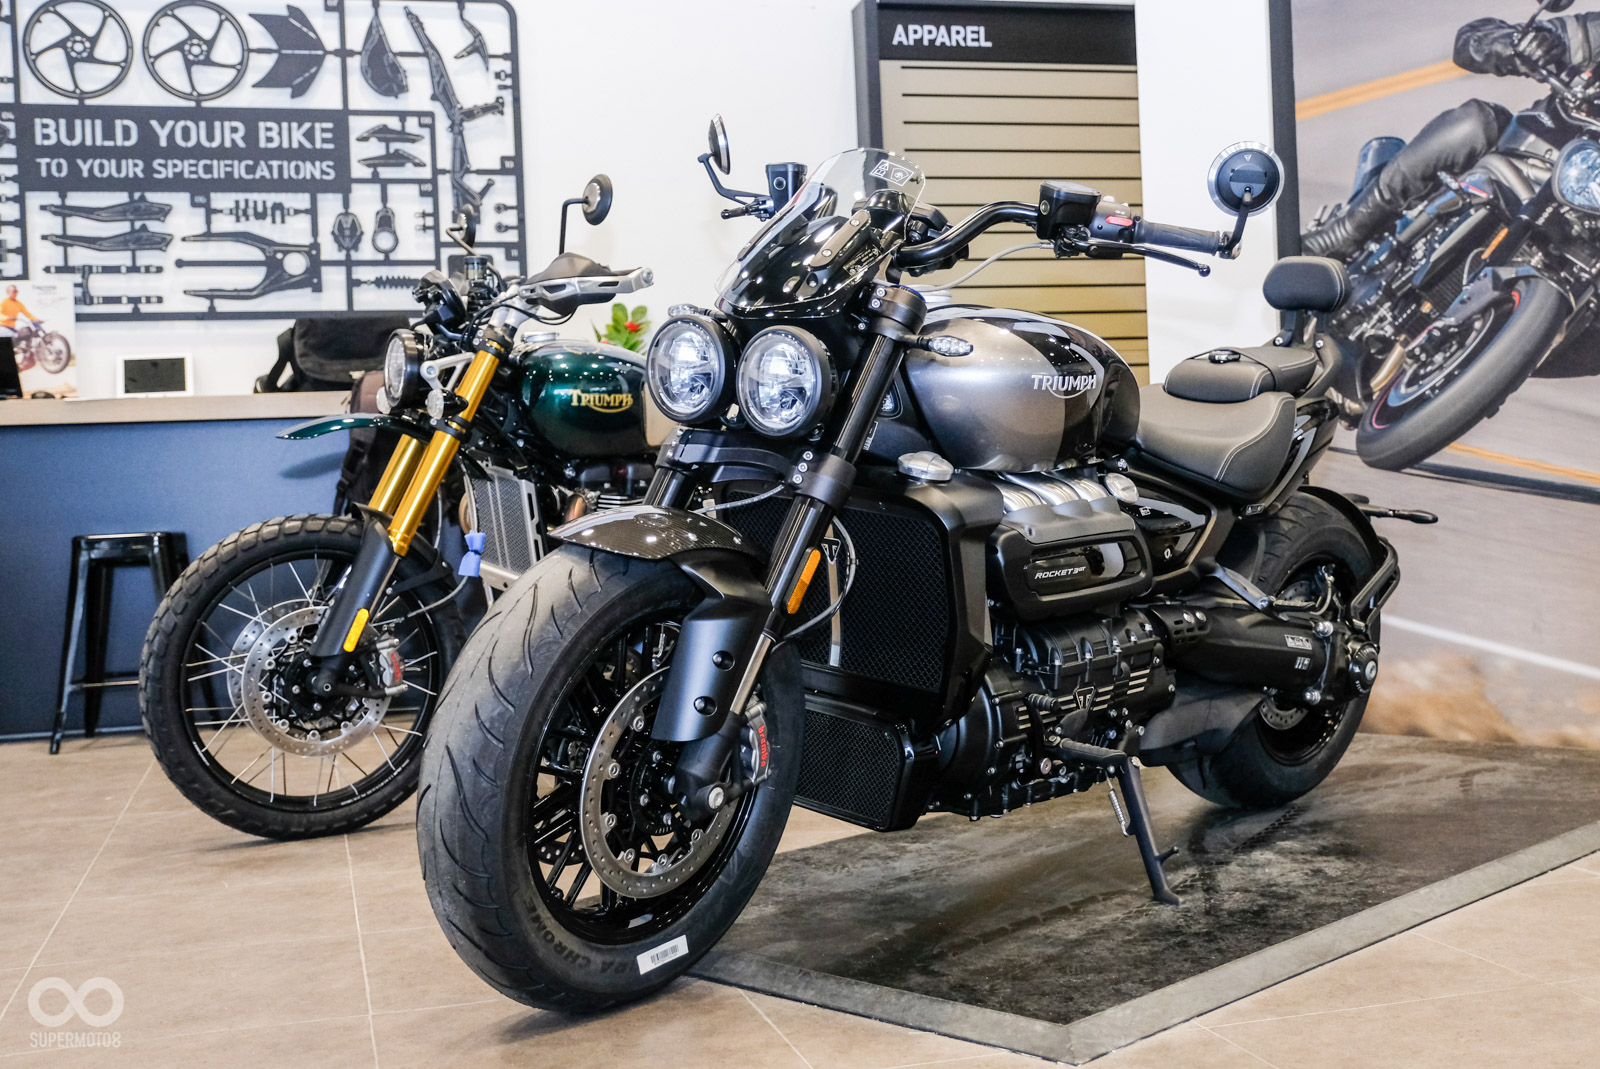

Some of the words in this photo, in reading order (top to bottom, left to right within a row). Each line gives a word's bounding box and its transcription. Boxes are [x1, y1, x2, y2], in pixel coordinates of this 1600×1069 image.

[892, 24, 993, 48] APPAREL
[34, 117, 139, 147] BUILD
[149, 119, 247, 148] YOUR
[258, 121, 336, 149] BIKE
[35, 157, 69, 178] TO
[76, 158, 145, 179] YOUR
[152, 158, 336, 181] SPECIFICATIONS
[1031, 374, 1097, 399] TRIUMPH
[568, 388, 634, 413] TRIUMPH
[758, 724, 768, 767] brembo
[523, 897, 592, 969] CHROME
